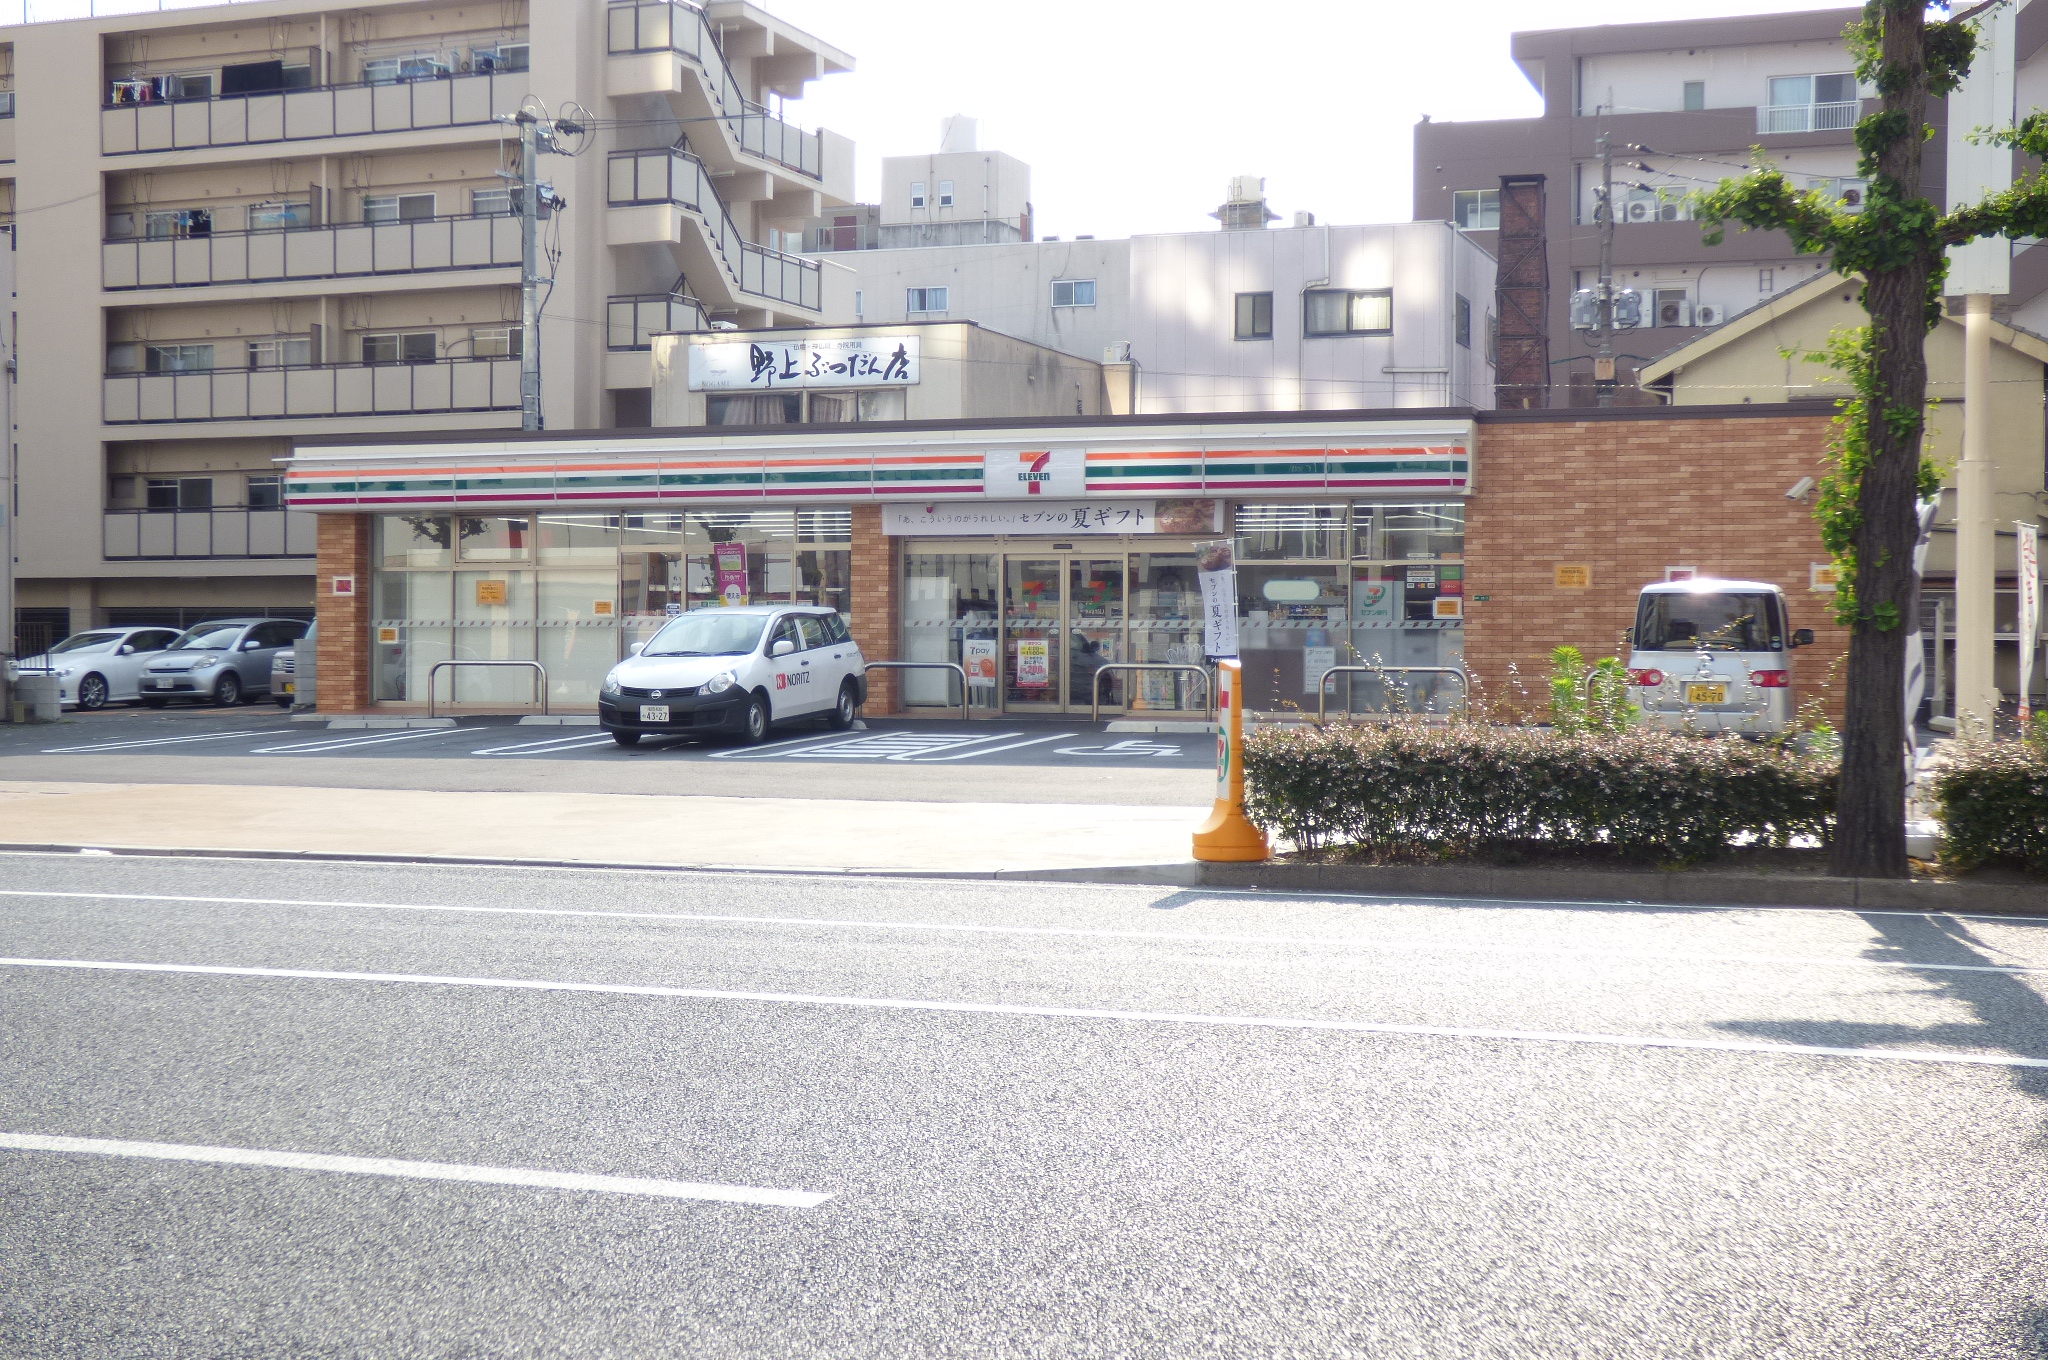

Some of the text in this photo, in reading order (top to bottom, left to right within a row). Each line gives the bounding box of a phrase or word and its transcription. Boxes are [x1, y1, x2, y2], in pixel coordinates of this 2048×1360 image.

[750, 342, 910, 388] 野上ぶつだん店
[1019, 507, 1145, 529] セブンの夏ギフト
[969, 646, 990, 655] 7pay
[786, 671, 810, 686] NORITZ
[646, 711, 668, 720] 43-27
